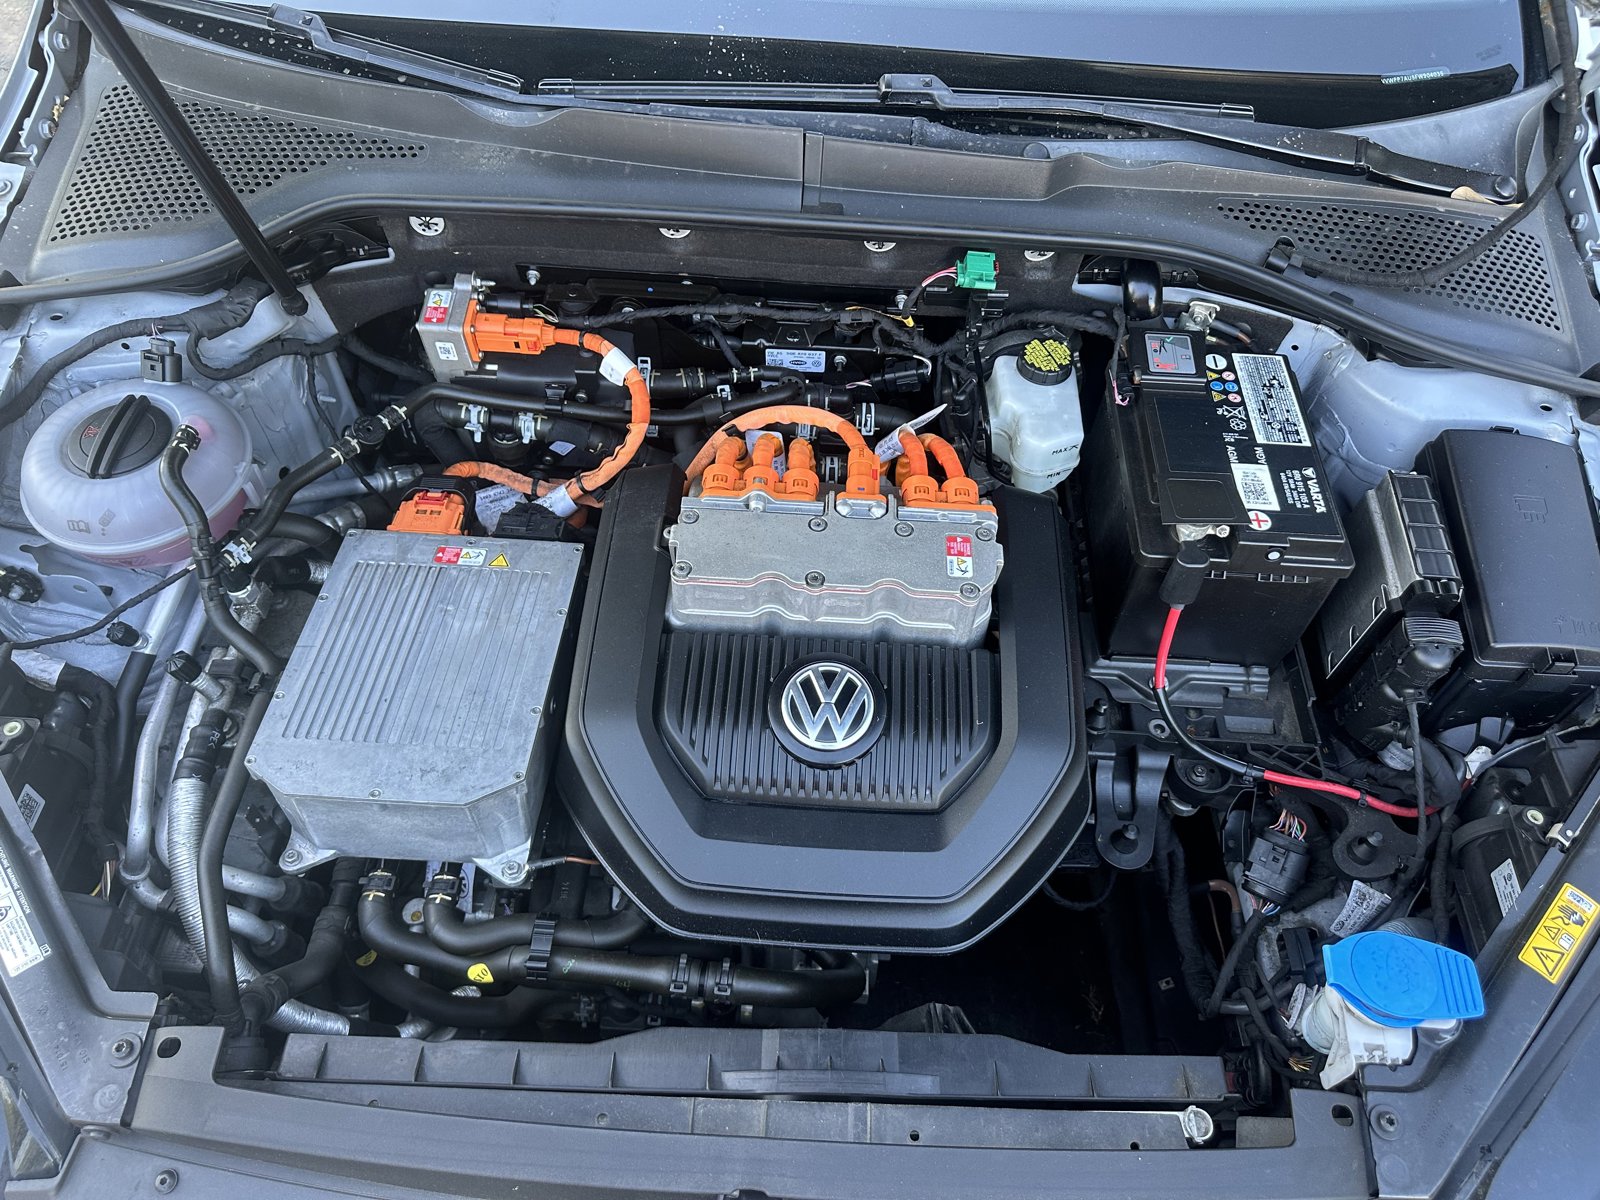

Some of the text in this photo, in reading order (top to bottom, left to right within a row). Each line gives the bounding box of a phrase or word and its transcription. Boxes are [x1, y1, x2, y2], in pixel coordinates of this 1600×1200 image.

[1052, 447, 1068, 455] MAX
[1226, 445, 1239, 463] AGM
[1254, 447, 1267, 465] AGM
[1295, 481, 1305, 492] 915
[1299, 493, 1309, 503] 105
[1307, 479, 1327, 513] VARTA
[6, 867, 20, 890] WARNING
[16, 889, 31, 914] ATTENTION
